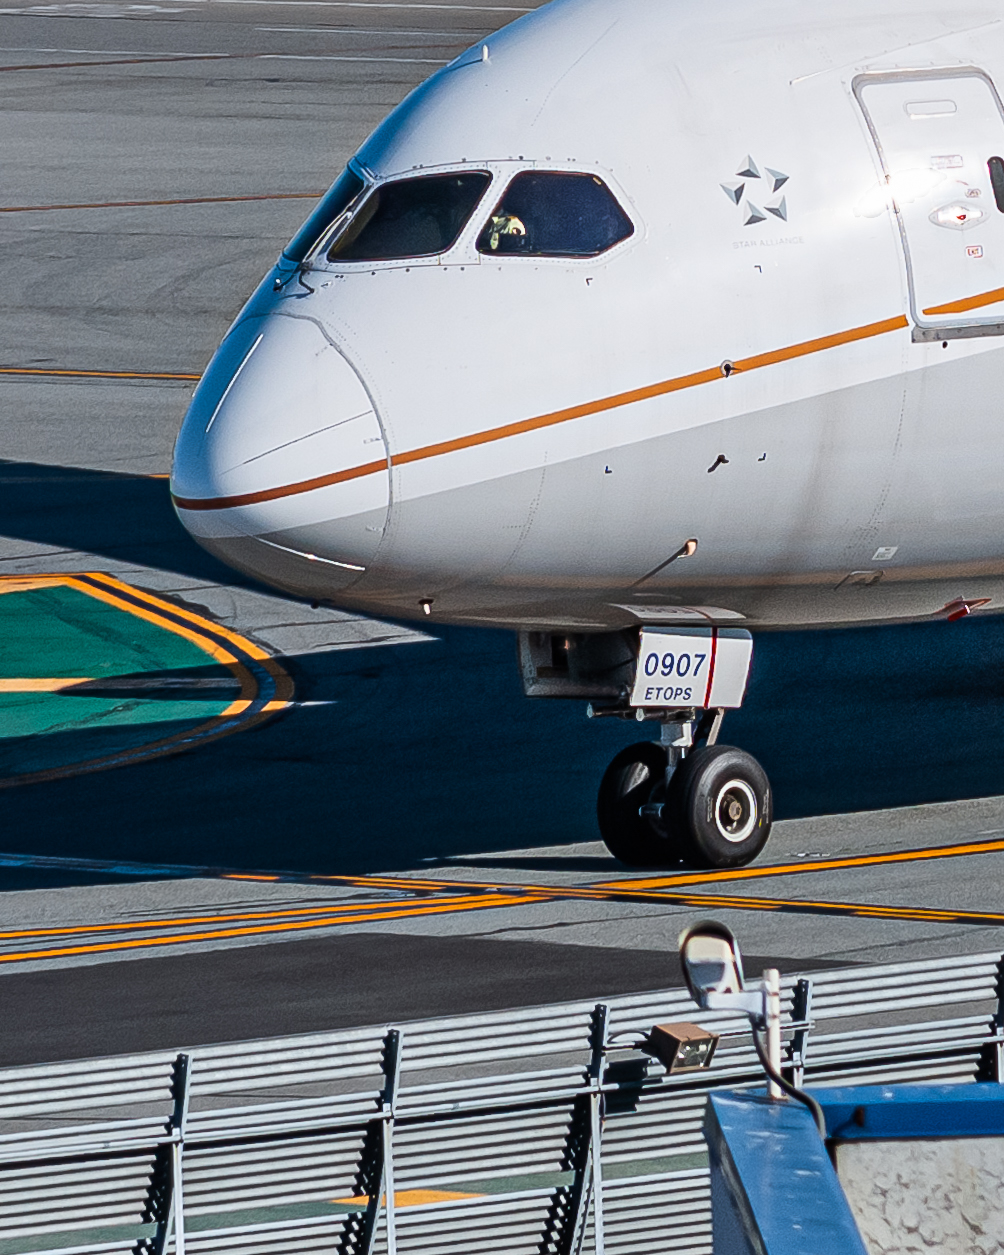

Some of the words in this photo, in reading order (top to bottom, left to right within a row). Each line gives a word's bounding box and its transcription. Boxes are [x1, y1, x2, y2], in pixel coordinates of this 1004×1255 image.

[760, 235, 805, 246] ALLIANCE
[644, 652, 707, 677] 0907
[644, 687, 693, 701] ETOPS
